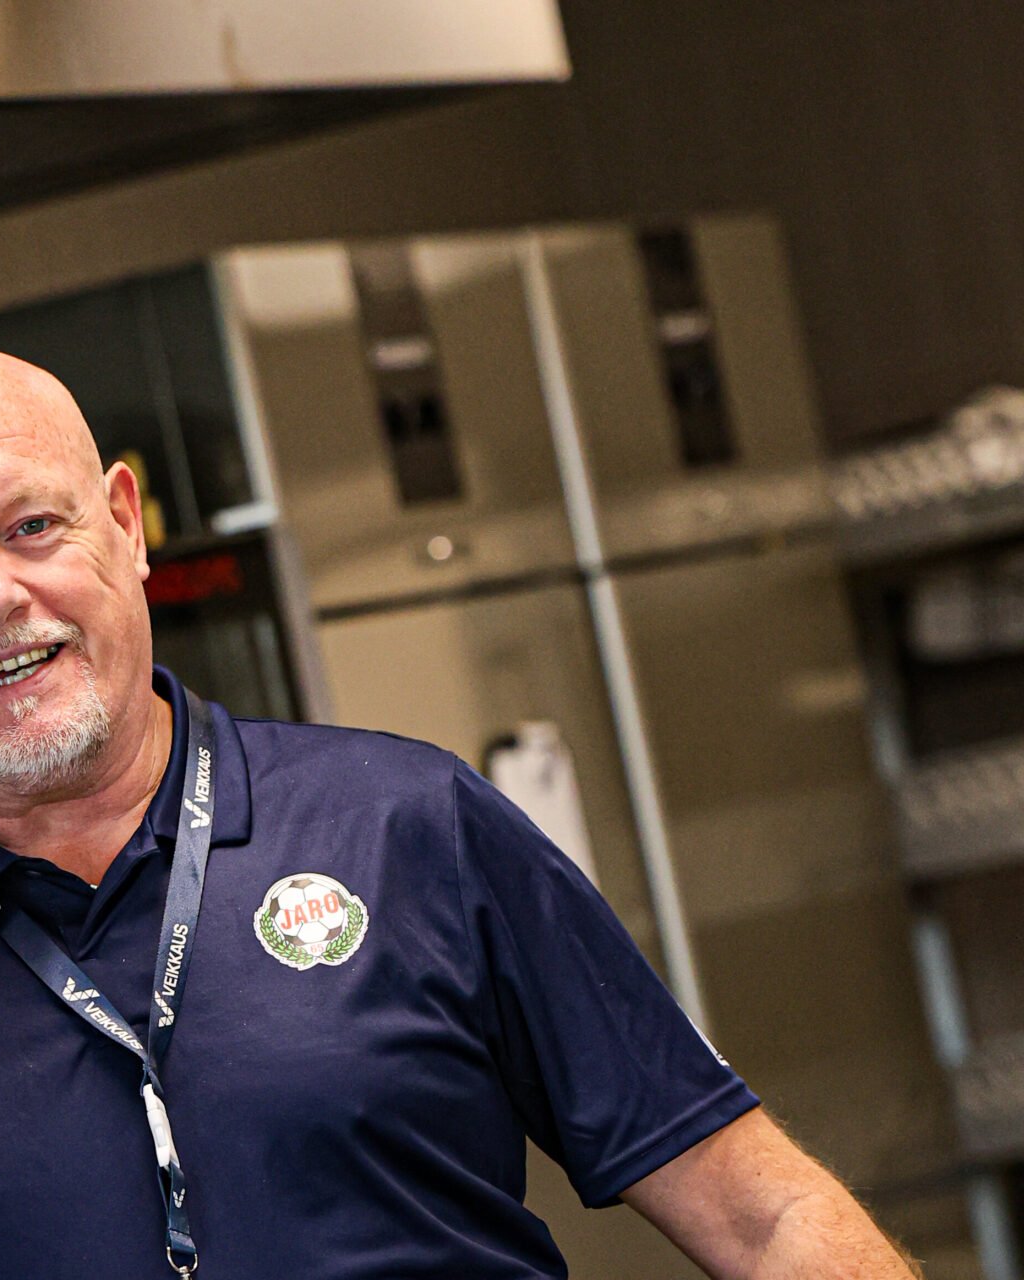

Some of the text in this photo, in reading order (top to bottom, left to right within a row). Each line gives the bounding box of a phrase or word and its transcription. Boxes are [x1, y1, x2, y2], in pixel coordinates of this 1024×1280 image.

[193, 746, 212, 803] VEIKKAUS
[280, 892, 340, 930] JARO
[161, 923, 189, 997] VEIKKAUS
[83, 1001, 144, 1051] VEIKKAUS
